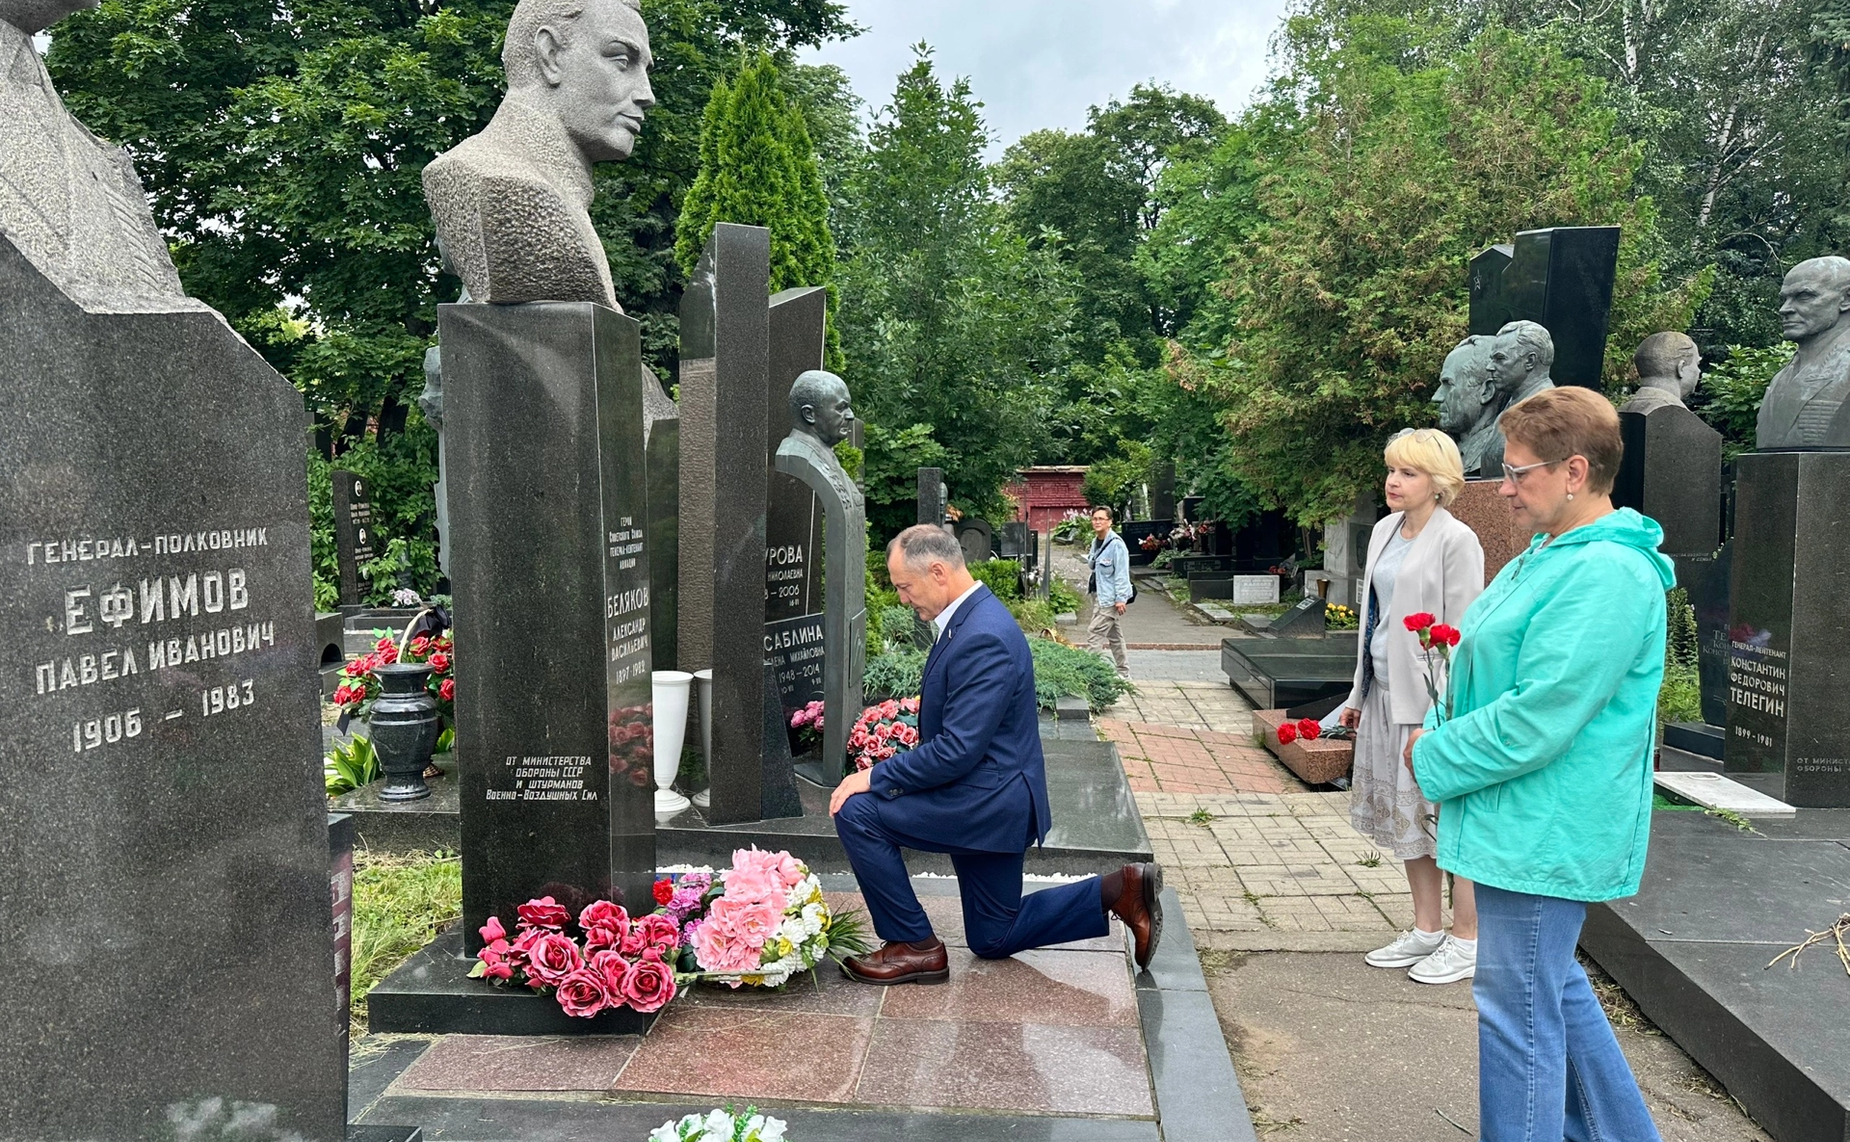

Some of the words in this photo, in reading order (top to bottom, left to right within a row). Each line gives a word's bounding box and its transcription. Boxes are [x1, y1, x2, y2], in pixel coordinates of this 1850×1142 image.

[26, 527, 268, 565] ГЕНЕРАЛ-ПОЛКОВНИК
[64, 567, 249, 635] ЕФИМОВ
[607, 587, 649, 619] БЕЛЯКОВ
[613, 617, 646, 642] АЛЕКСАНДР
[764, 624, 824, 652] САБЛИНА
[35, 646, 139, 694] ПАВЕЛ
[148, 620, 275, 670] ИВАНОВИЧ
[611, 634, 648, 662] ВАСИЛЬЕВИЧ
[1731, 640, 1786, 659] ГЕНЕРАЛ-ЛЕЙТЕНАНТ
[1730, 655, 1786, 680] КОНСТАНТИН
[1730, 671, 1785, 696] ФЕДОРОВИЧ
[1730, 686, 1784, 718] ТЕЛЕГИН
[73, 706, 142, 753] 1906
[202, 678, 256, 716] 1983
[505, 756, 517, 766] ОТ
[522, 756, 592, 766] МИНИСТЕРСТВА
[515, 767, 560, 778] ОБОРОНЫ
[562, 766, 584, 778] СССР
[1812, 757, 1850, 765] МИНИСТ
[515, 780, 523, 789] И
[528, 780, 584, 789] ШТУРМАНОВ
